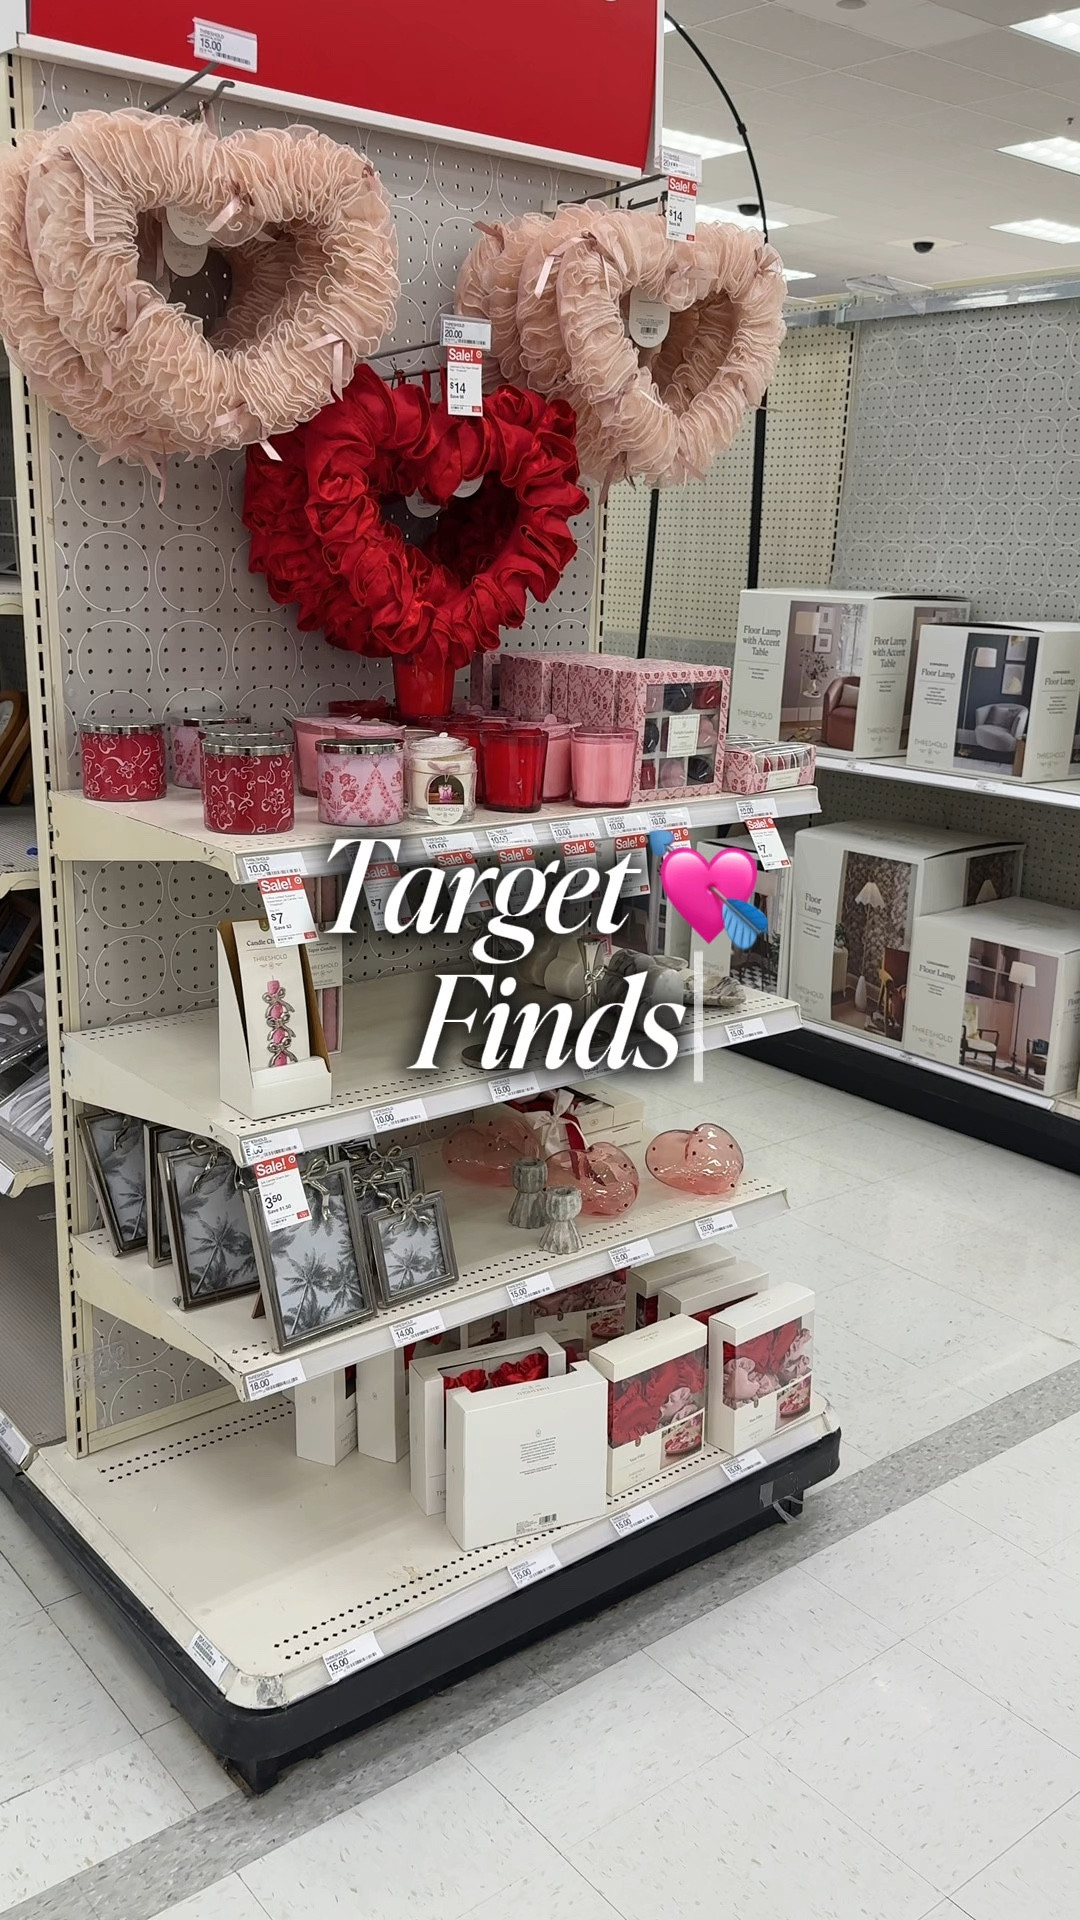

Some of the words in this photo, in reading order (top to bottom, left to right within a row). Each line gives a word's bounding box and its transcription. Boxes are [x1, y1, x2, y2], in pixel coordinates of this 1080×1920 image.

[200, 38, 222, 52] 15.00
[669, 179, 690, 193] Sale!
[669, 209, 683, 222] $14
[445, 329, 463, 339] 20.00
[448, 348, 474, 362] Sale!
[450, 382, 466, 394] $14
[743, 625, 761, 634] Floor
[761, 626, 782, 638] Lamp
[742, 636, 757, 645] with
[758, 637, 781, 647] Accent
[873, 636, 890, 646] Floor
[890, 637, 907, 647] Lamp
[751, 647, 769, 657] Table
[872, 648, 886, 657] with
[886, 648, 906, 657] Accent
[921, 668, 937, 677] Floor
[937, 670, 956, 680] Lamp
[1044, 677, 1060, 686] Floor
[1060, 677, 1076, 686] Lamp
[738, 709, 773, 720] THRESHOLD
[914, 738, 948, 749] THRESHOLD
[609, 822, 625, 830] 10.00
[651, 817, 667, 825] 10.00
[746, 819, 769, 829] Sale!
[554, 828, 571, 837] 10.00
[564, 843, 588, 855] Sale!
[616, 837, 638, 850] Sale!
[758, 844, 766, 854] $7
[437, 854, 466, 866] Sale!
[499, 851, 525, 862] Sale!
[248, 863, 270, 874] 10.00
[260, 877, 293, 893] Sale!
[370, 898, 382, 910] $7
[805, 892, 822, 905] Floor
[804, 902, 822, 916] Lamp
[270, 912, 283, 925] $7
[246, 938, 266, 947] Candle
[252, 953, 288, 962] THRESHOLD
[919, 964, 937, 975] Floor
[937, 969, 956, 982] Lamp
[730, 1029, 745, 1037] 15.00
[912, 1025, 953, 1043] THRESHOLD
[493, 1085, 511, 1095] 15.00
[375, 1113, 395, 1124] 10.00
[256, 1157, 287, 1176] Sale!
[612, 1252, 628, 1263] 15.00
[510, 1287, 528, 1298] 15.00
[395, 1326, 415, 1339] 14.00
[250, 1378, 270, 1392] 18.00
[615, 1518, 632, 1530] 15.00
[513, 1568, 532, 1581] 15.00
[329, 1657, 349, 1672] 15.00
